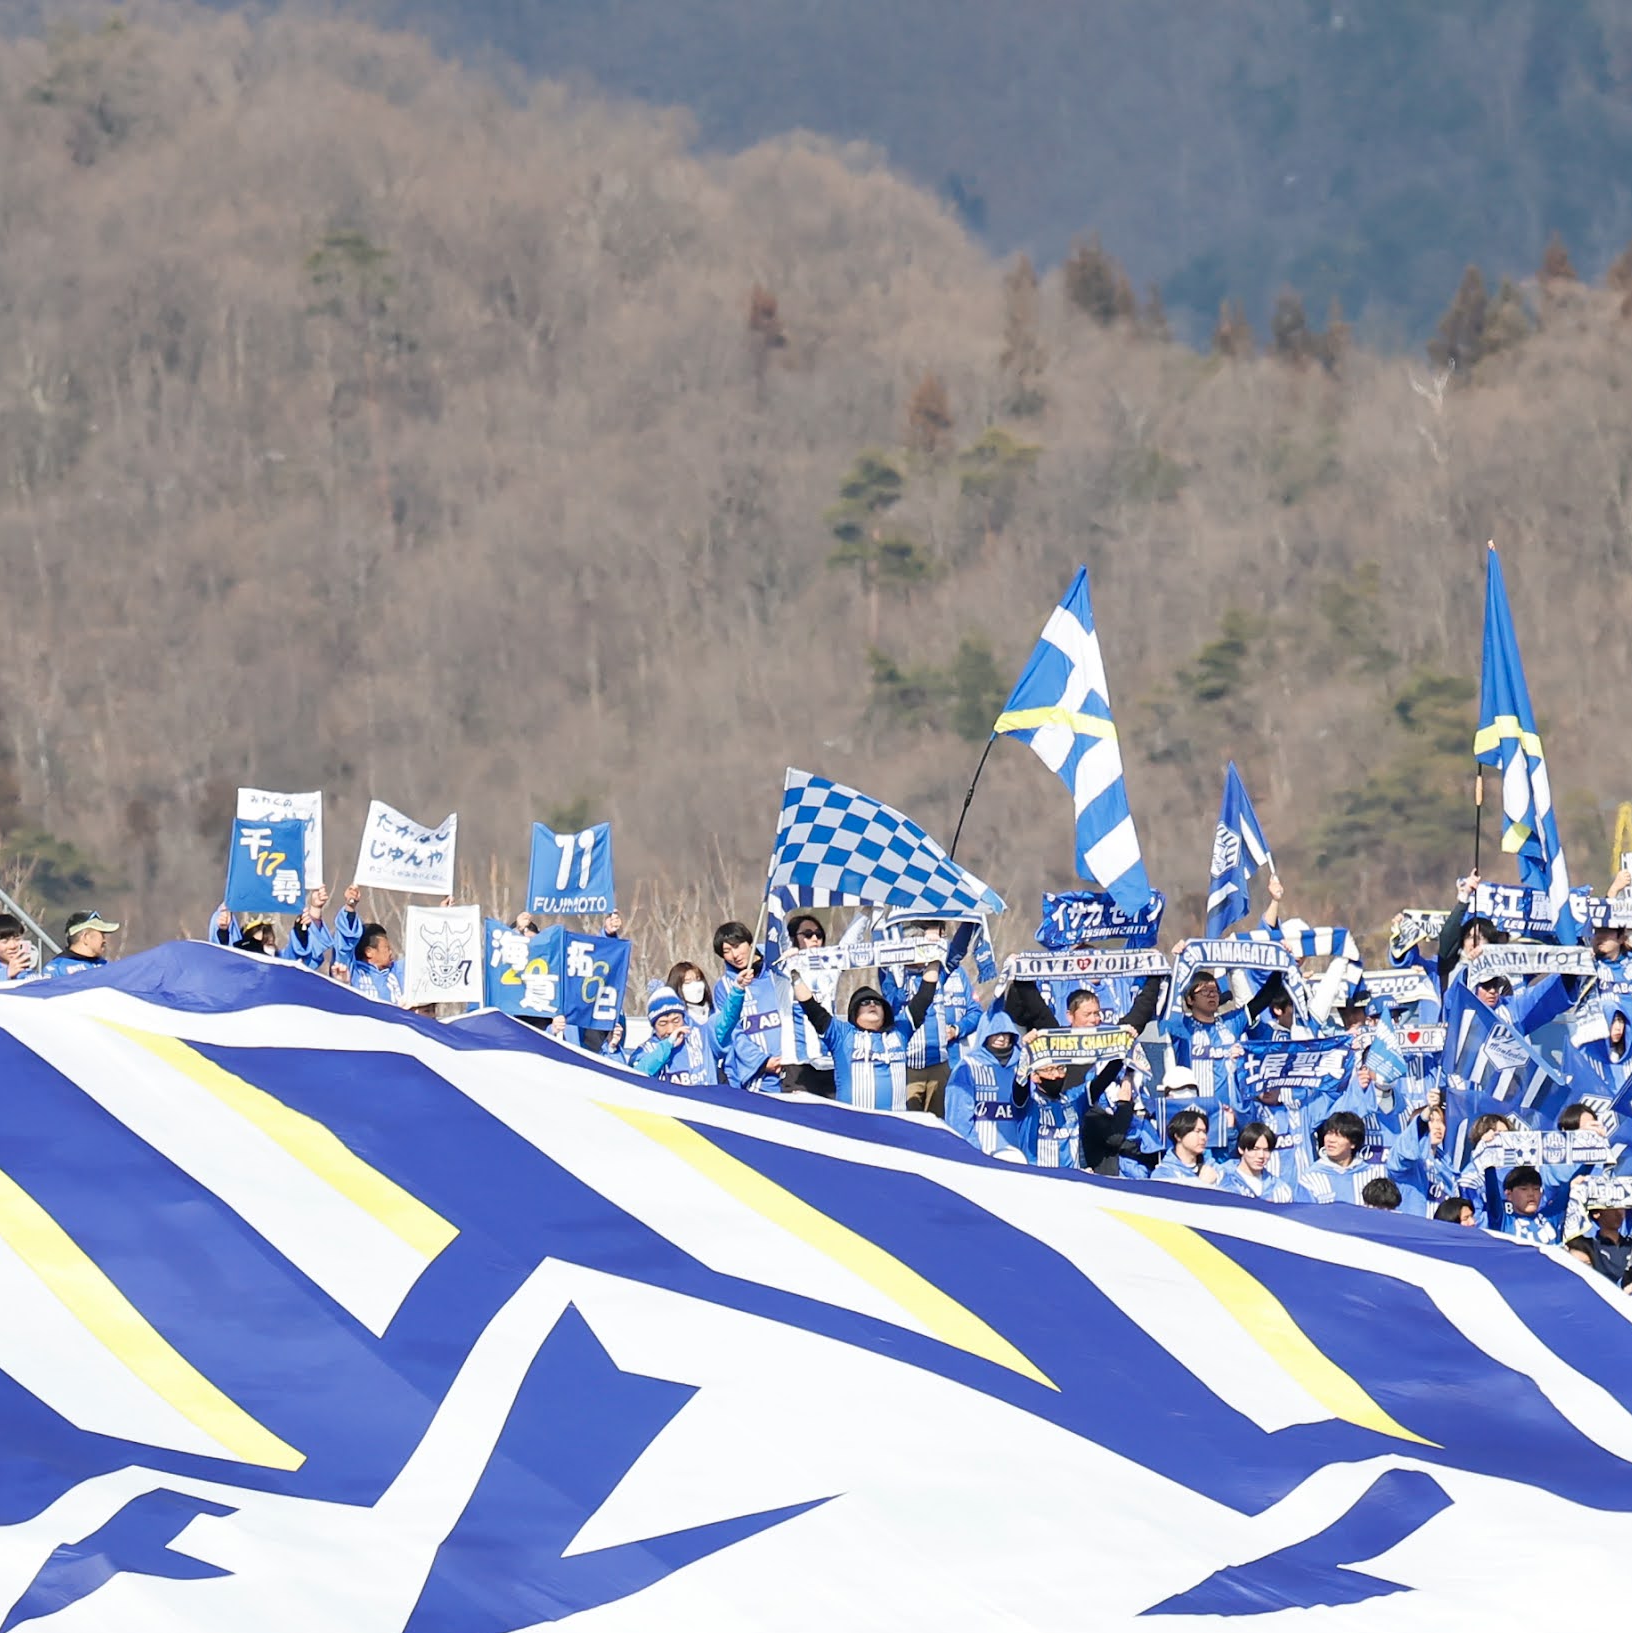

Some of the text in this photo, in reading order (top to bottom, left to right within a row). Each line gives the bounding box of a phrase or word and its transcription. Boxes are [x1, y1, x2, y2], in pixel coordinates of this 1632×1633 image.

[257, 851, 286, 875] 17
[370, 841, 443, 866] じゅんや
[555, 832, 595, 889] 11
[534, 896, 607, 911] FUJIMOTO
[567, 940, 594, 976] 拓
[1203, 946, 1275, 964] YAMAGATA
[523, 976, 559, 1011] 夏
